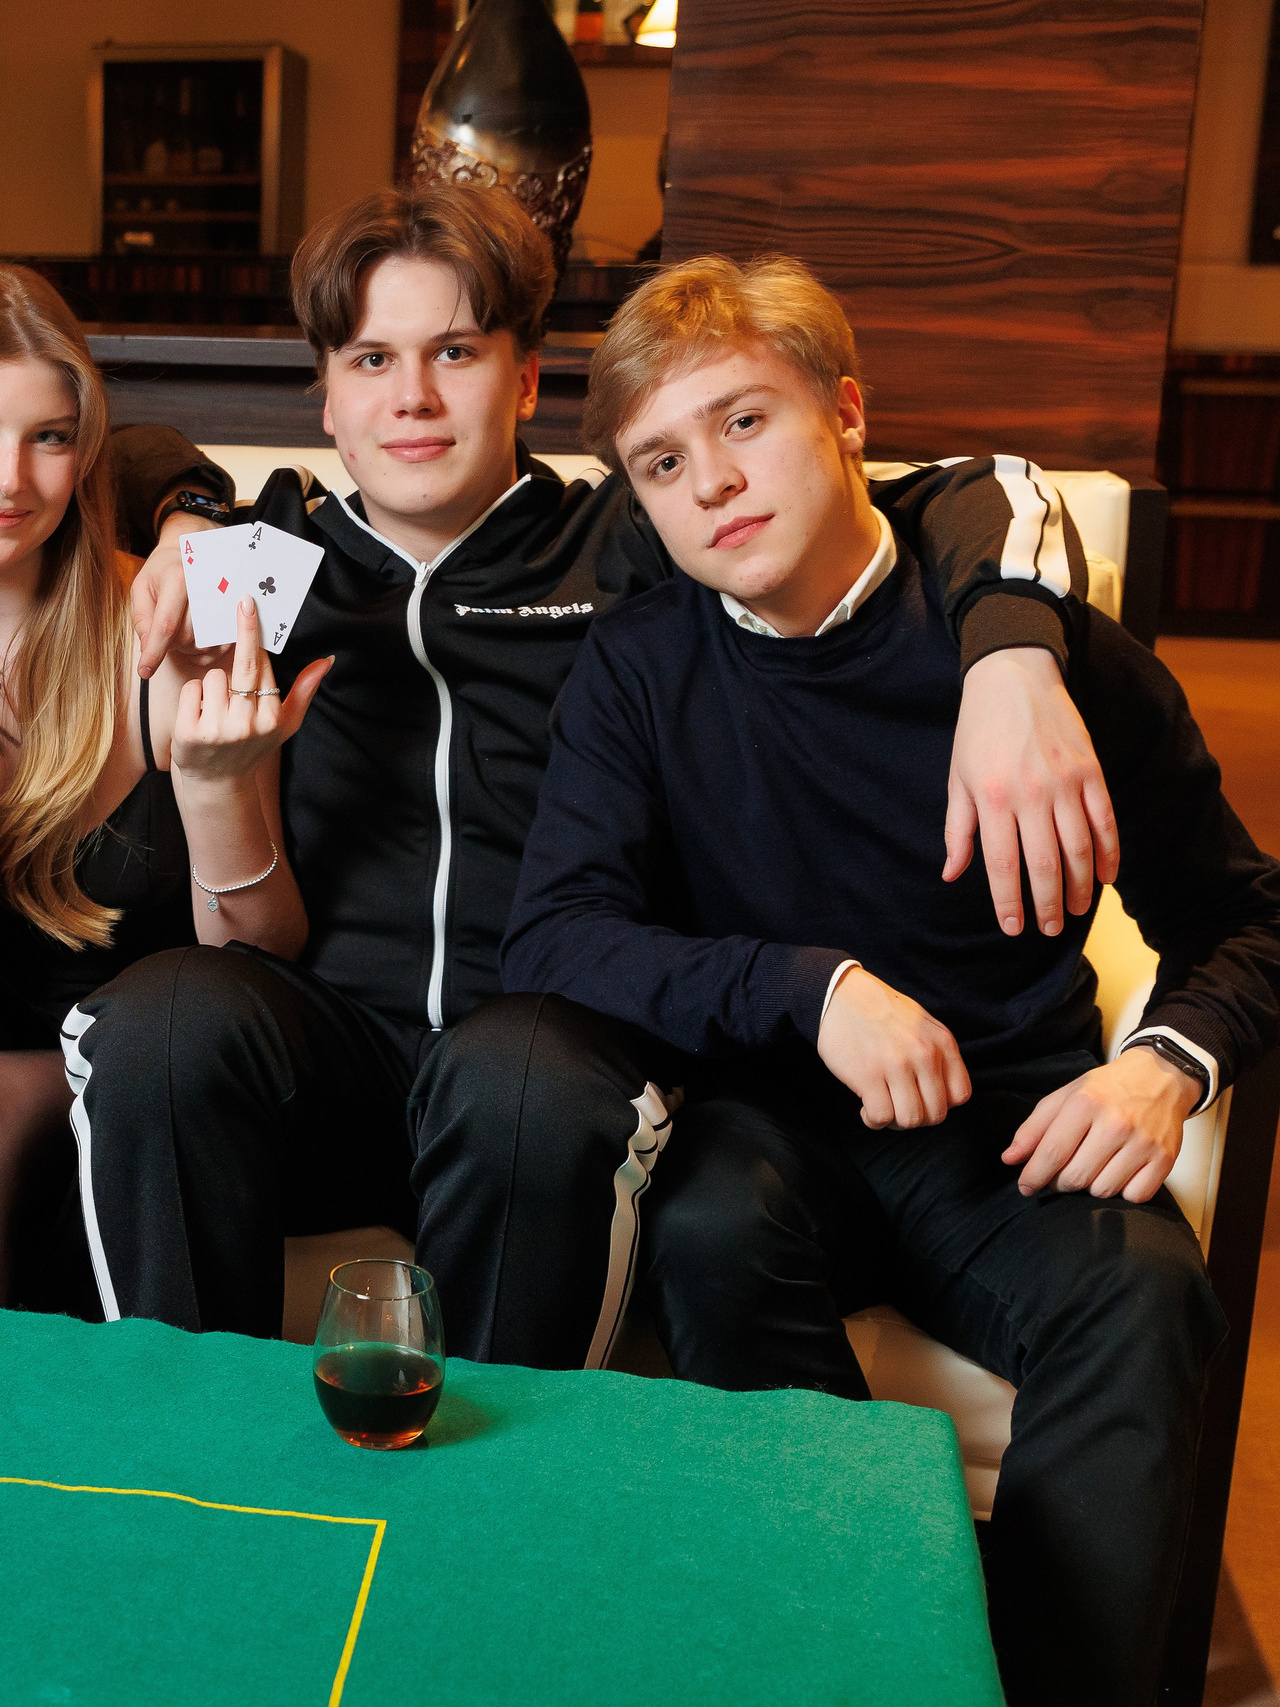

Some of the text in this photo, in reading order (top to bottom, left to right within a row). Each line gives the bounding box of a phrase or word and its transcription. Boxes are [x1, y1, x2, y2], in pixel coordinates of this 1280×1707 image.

[252, 527, 262, 541] A
[184, 540, 194, 554] A
[518, 602, 594, 619] Angels
[273, 632, 284, 646] A
